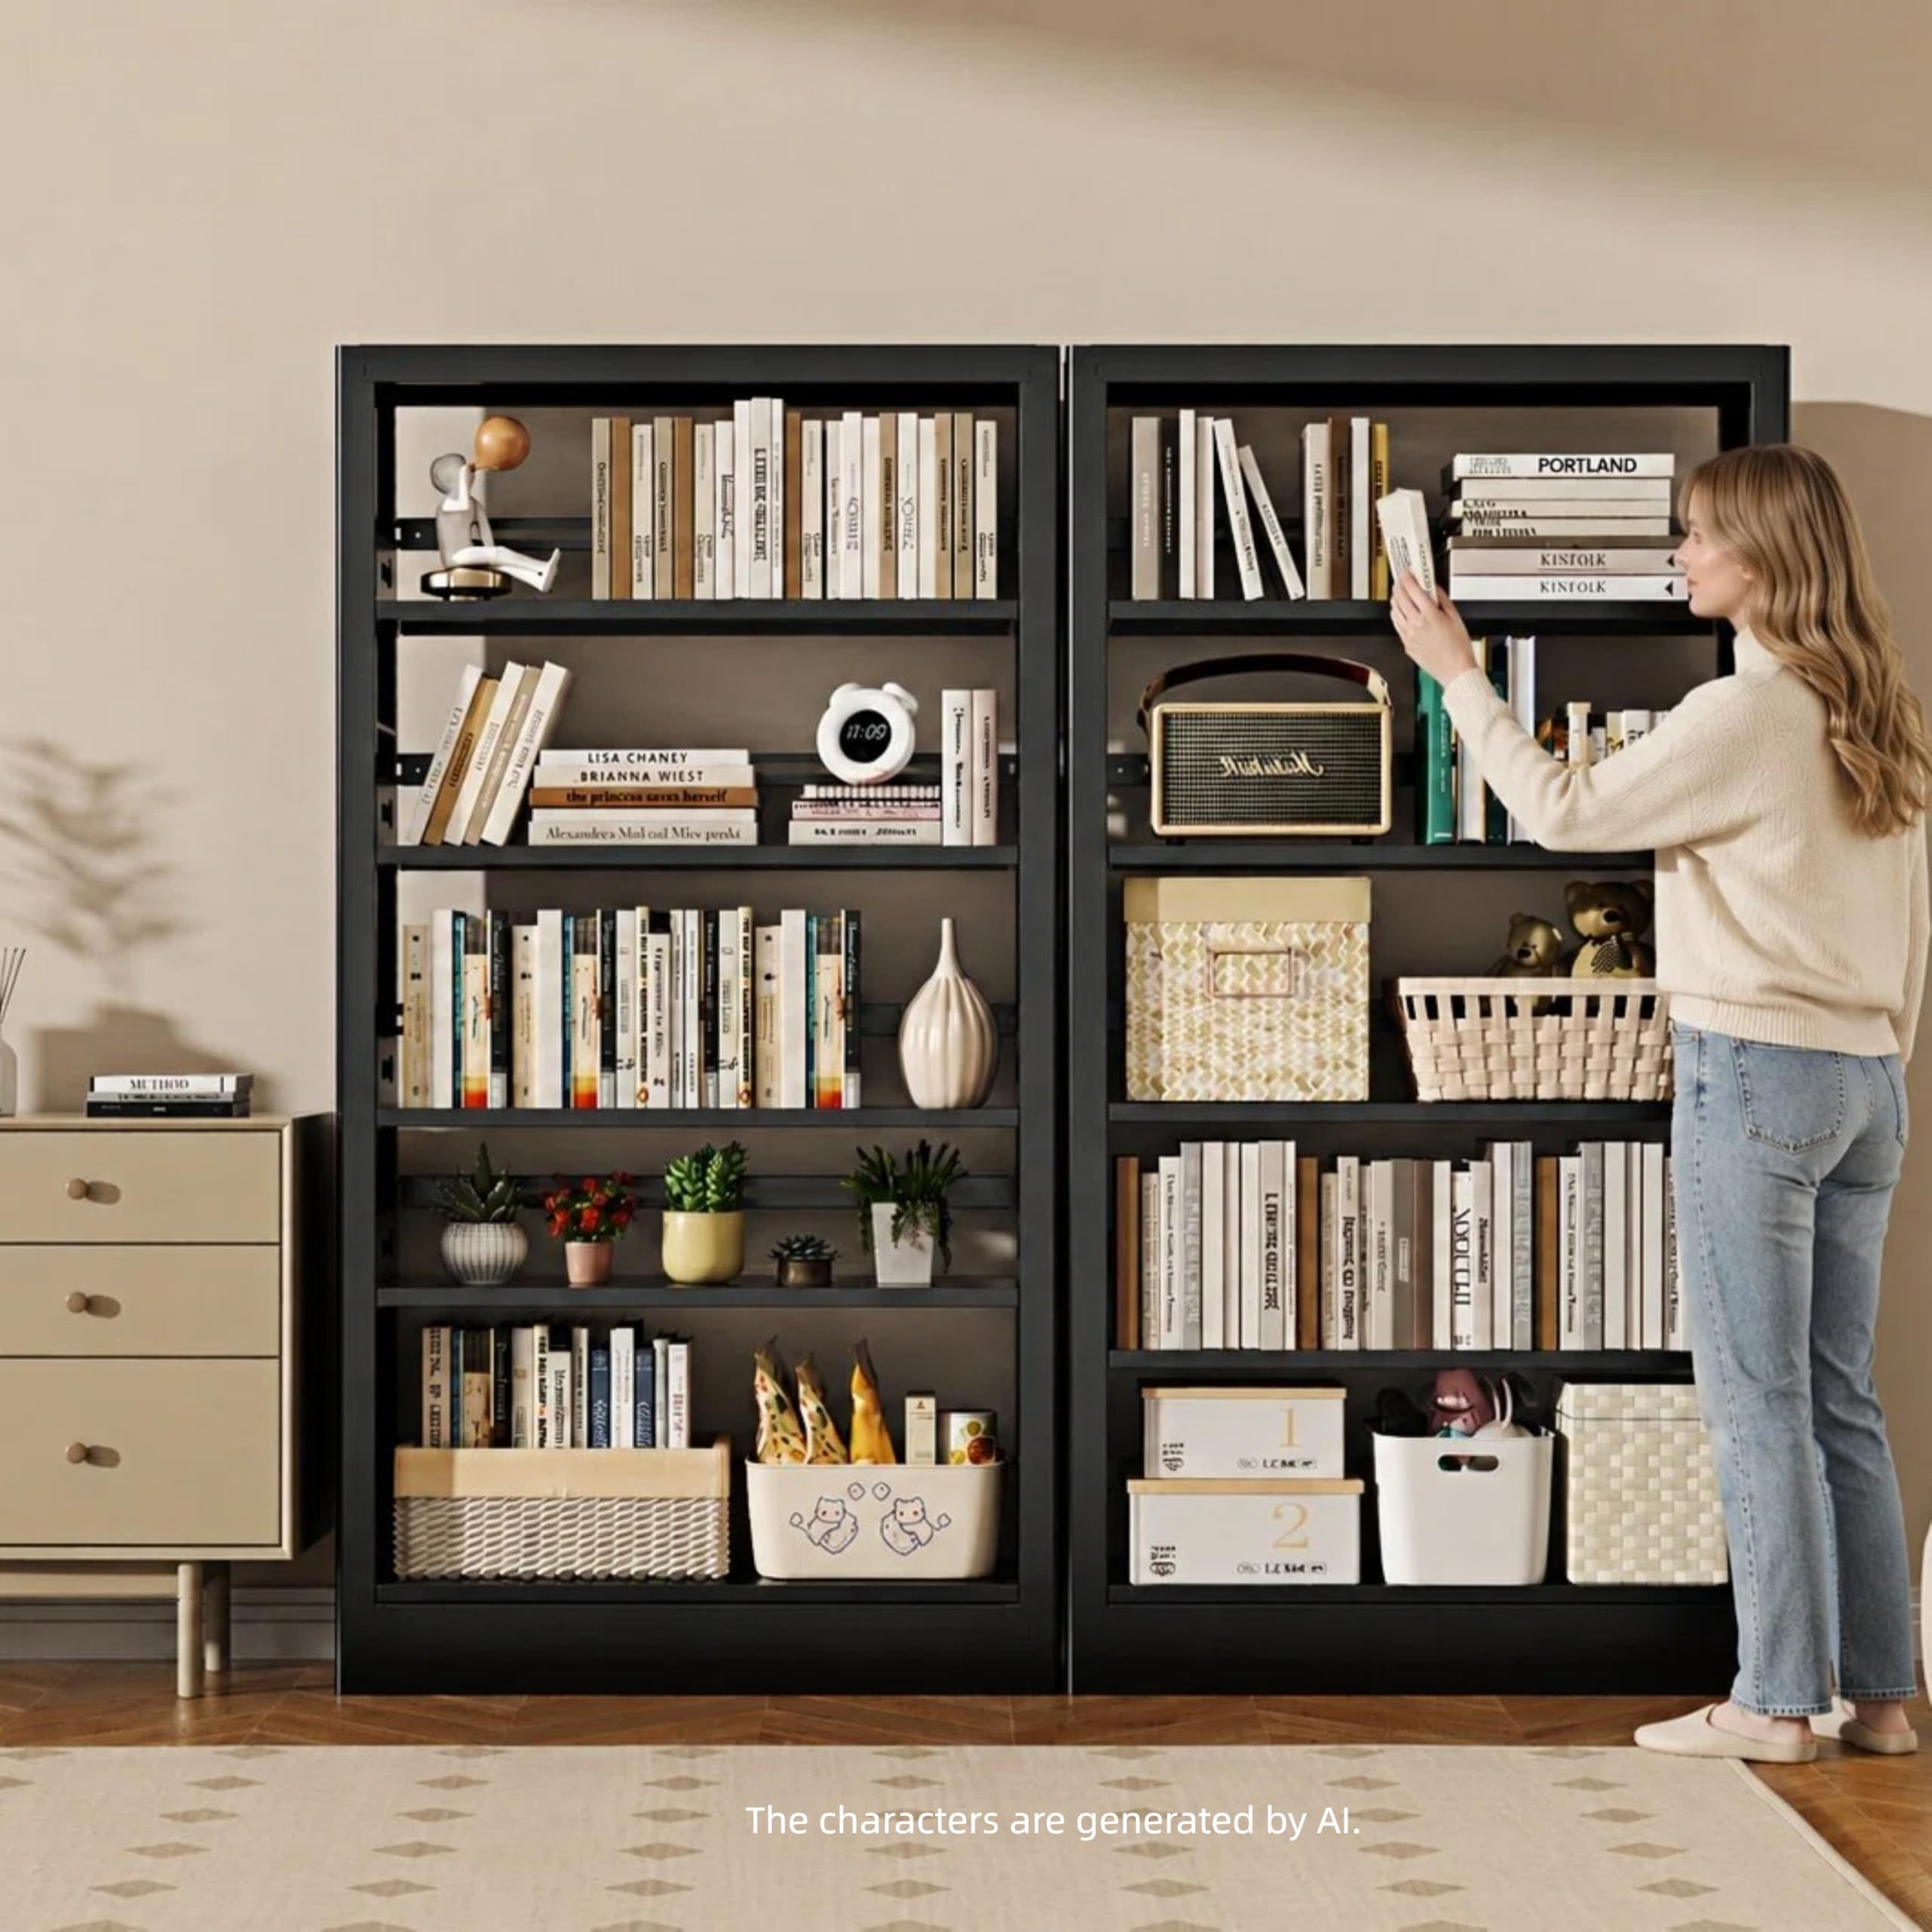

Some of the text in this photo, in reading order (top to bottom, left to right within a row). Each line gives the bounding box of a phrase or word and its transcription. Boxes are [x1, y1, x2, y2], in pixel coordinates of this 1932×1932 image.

[1537, 457, 1638, 474] PORTLAND
[588, 752, 688, 764] LISA CHANEY
[580, 770, 705, 783] BRIANNA WIEST
[1279, 1407, 1303, 1448] 1
[1272, 1503, 1309, 1549] 2
